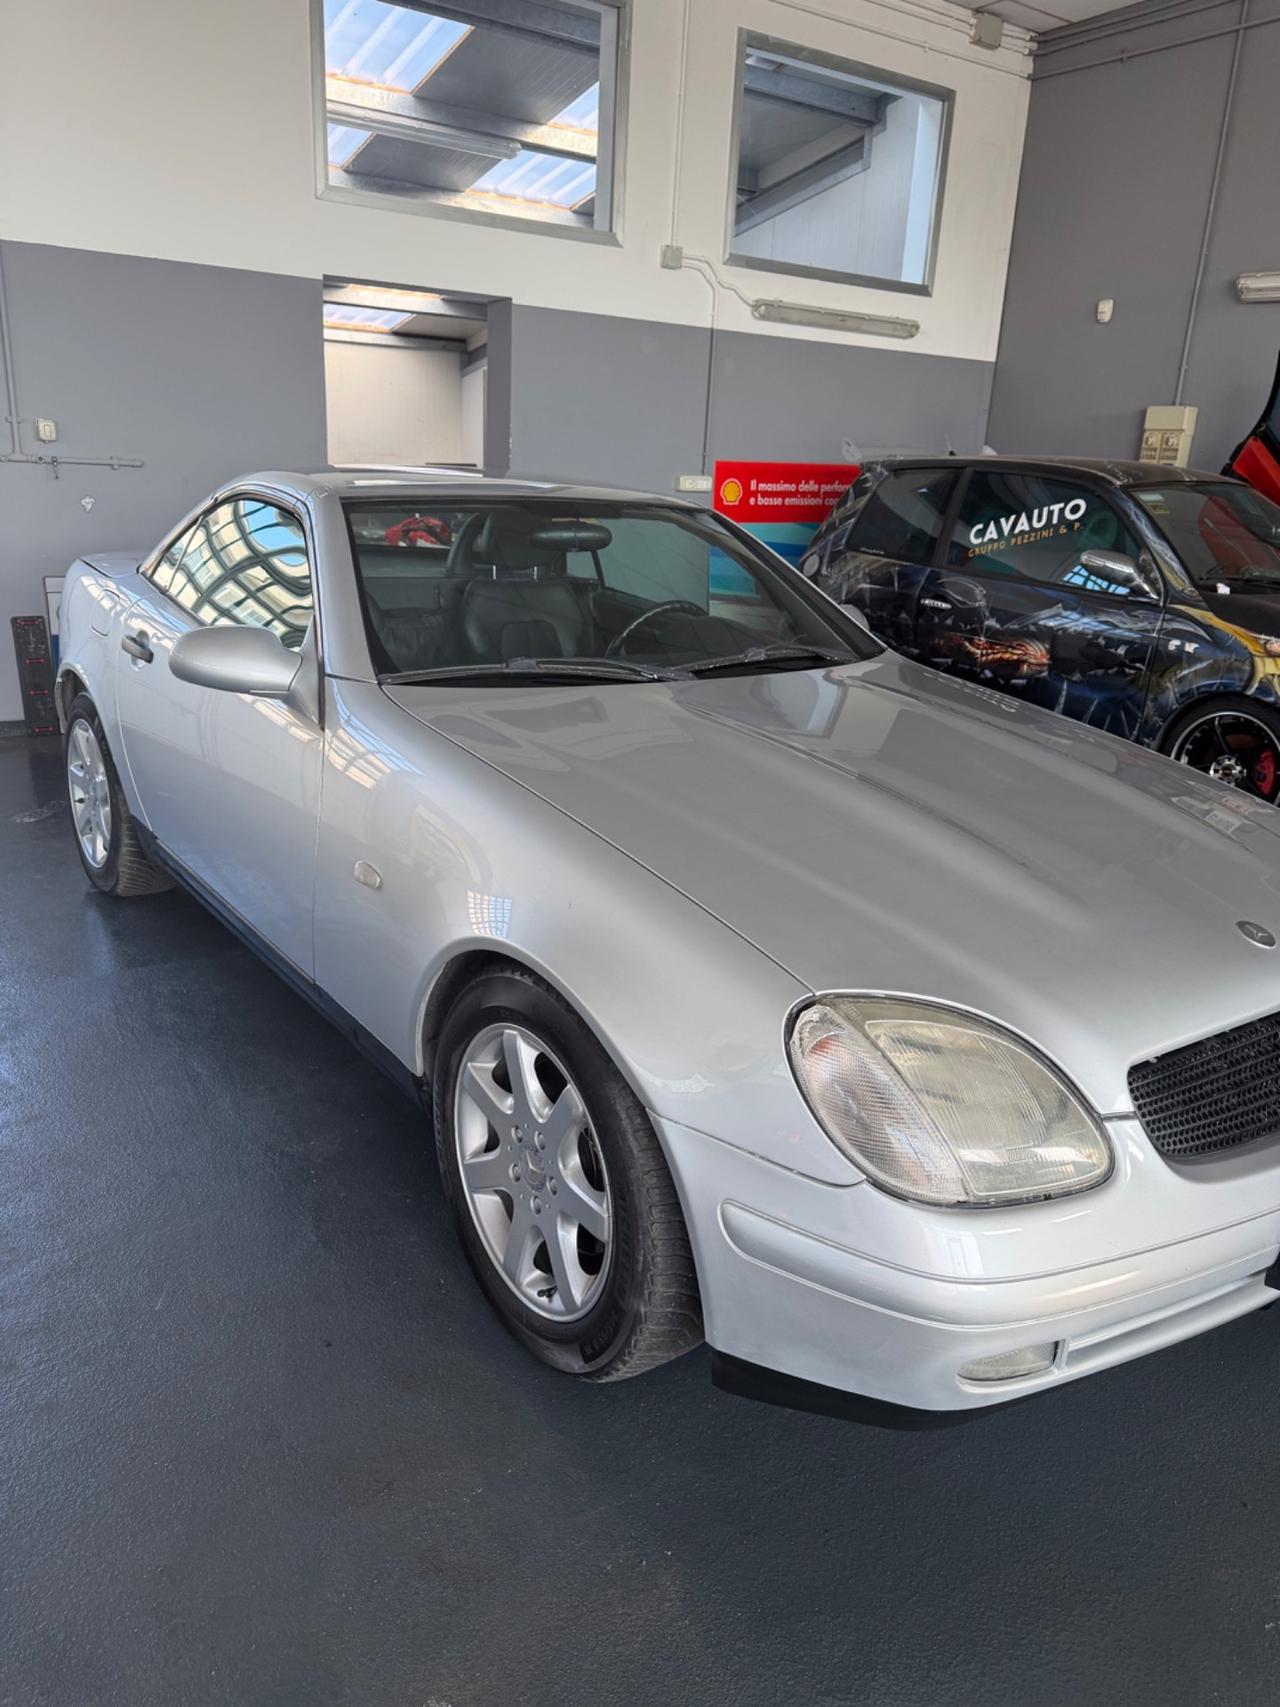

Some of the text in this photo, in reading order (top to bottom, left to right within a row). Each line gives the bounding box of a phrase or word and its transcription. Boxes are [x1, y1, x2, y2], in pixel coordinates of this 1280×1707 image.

[750, 479, 757, 491] Il
[758, 480, 796, 491] massimo
[798, 480, 819, 492] delle
[749, 497, 756, 506] e
[757, 494, 783, 506] basse
[784, 495, 823, 506] emissioni
[969, 498, 1087, 545] CAVAUTO
[968, 540, 1006, 558] GRUPPO
[1010, 529, 1054, 546] PEZZINI
[1059, 525, 1067, 535] &
